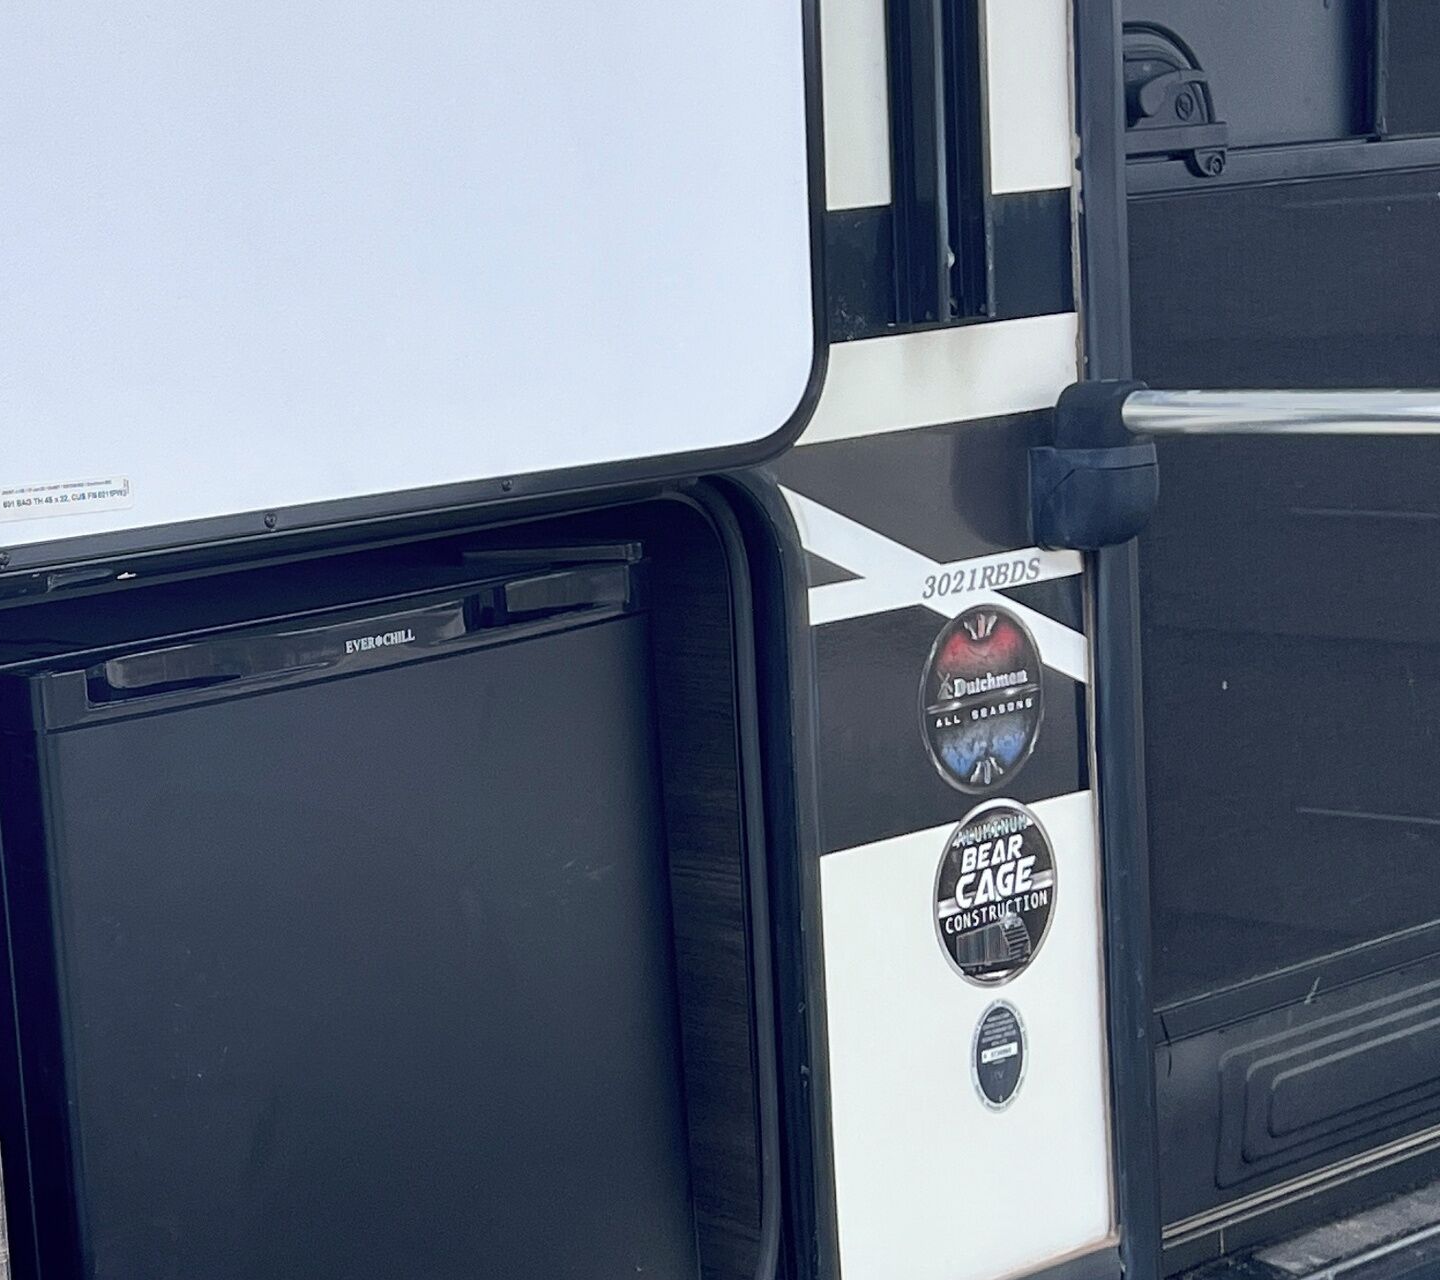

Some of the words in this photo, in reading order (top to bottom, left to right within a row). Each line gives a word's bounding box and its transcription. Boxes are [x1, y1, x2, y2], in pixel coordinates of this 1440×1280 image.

[922, 557, 1041, 599] 3021RBDS
[953, 669, 1028, 698] Dutchmen
[935, 714, 962, 728] ALL
[971, 697, 1033, 720] SEASONS
[952, 814, 1028, 848] ALUMINUM
[961, 833, 1023, 874] BEAR
[955, 854, 1037, 909] CAGE
[945, 889, 1048, 934] CONSTRUCTION
